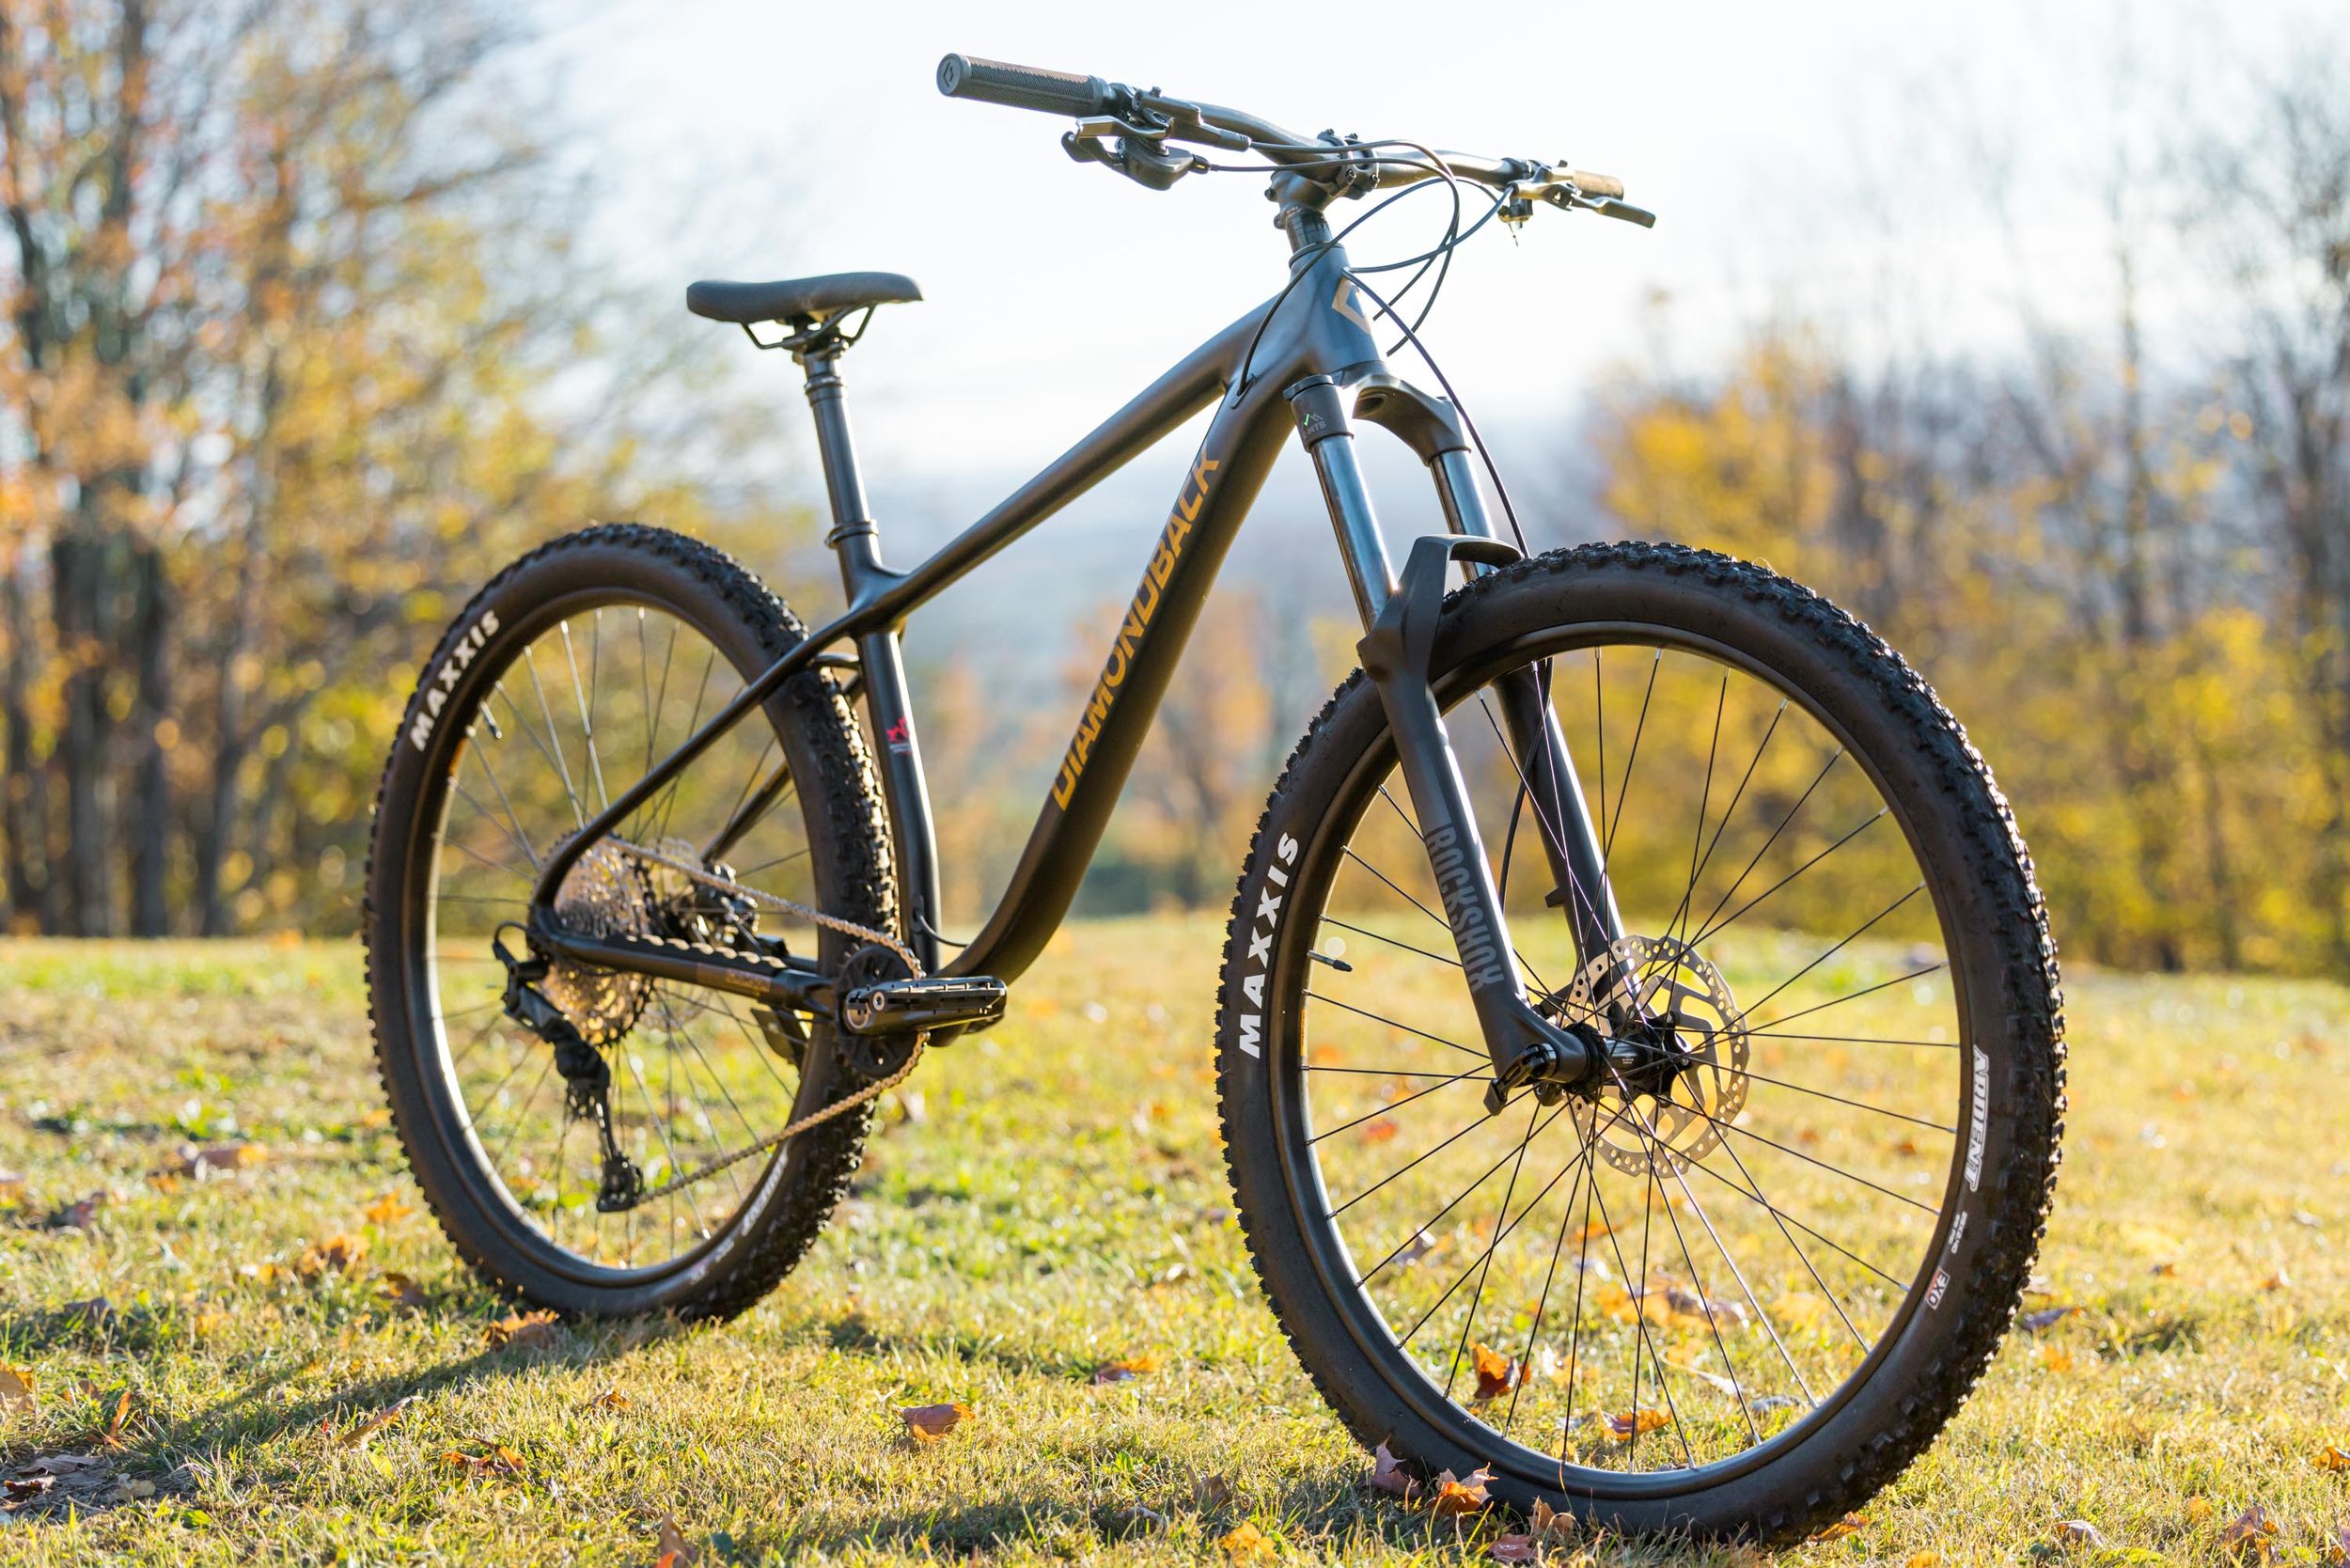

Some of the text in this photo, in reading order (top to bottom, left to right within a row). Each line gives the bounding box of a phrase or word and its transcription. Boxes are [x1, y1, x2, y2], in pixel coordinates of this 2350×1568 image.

[410, 610, 499, 752] MAXXIS
[1052, 447, 1219, 810] DIAMONDBACK
[1239, 832, 1298, 1059] MAXXIS
[1428, 827, 1504, 993] ROCKSHOX
[1965, 1044, 1989, 1192] ARDENT
[1928, 1271, 1949, 1307] EXO
